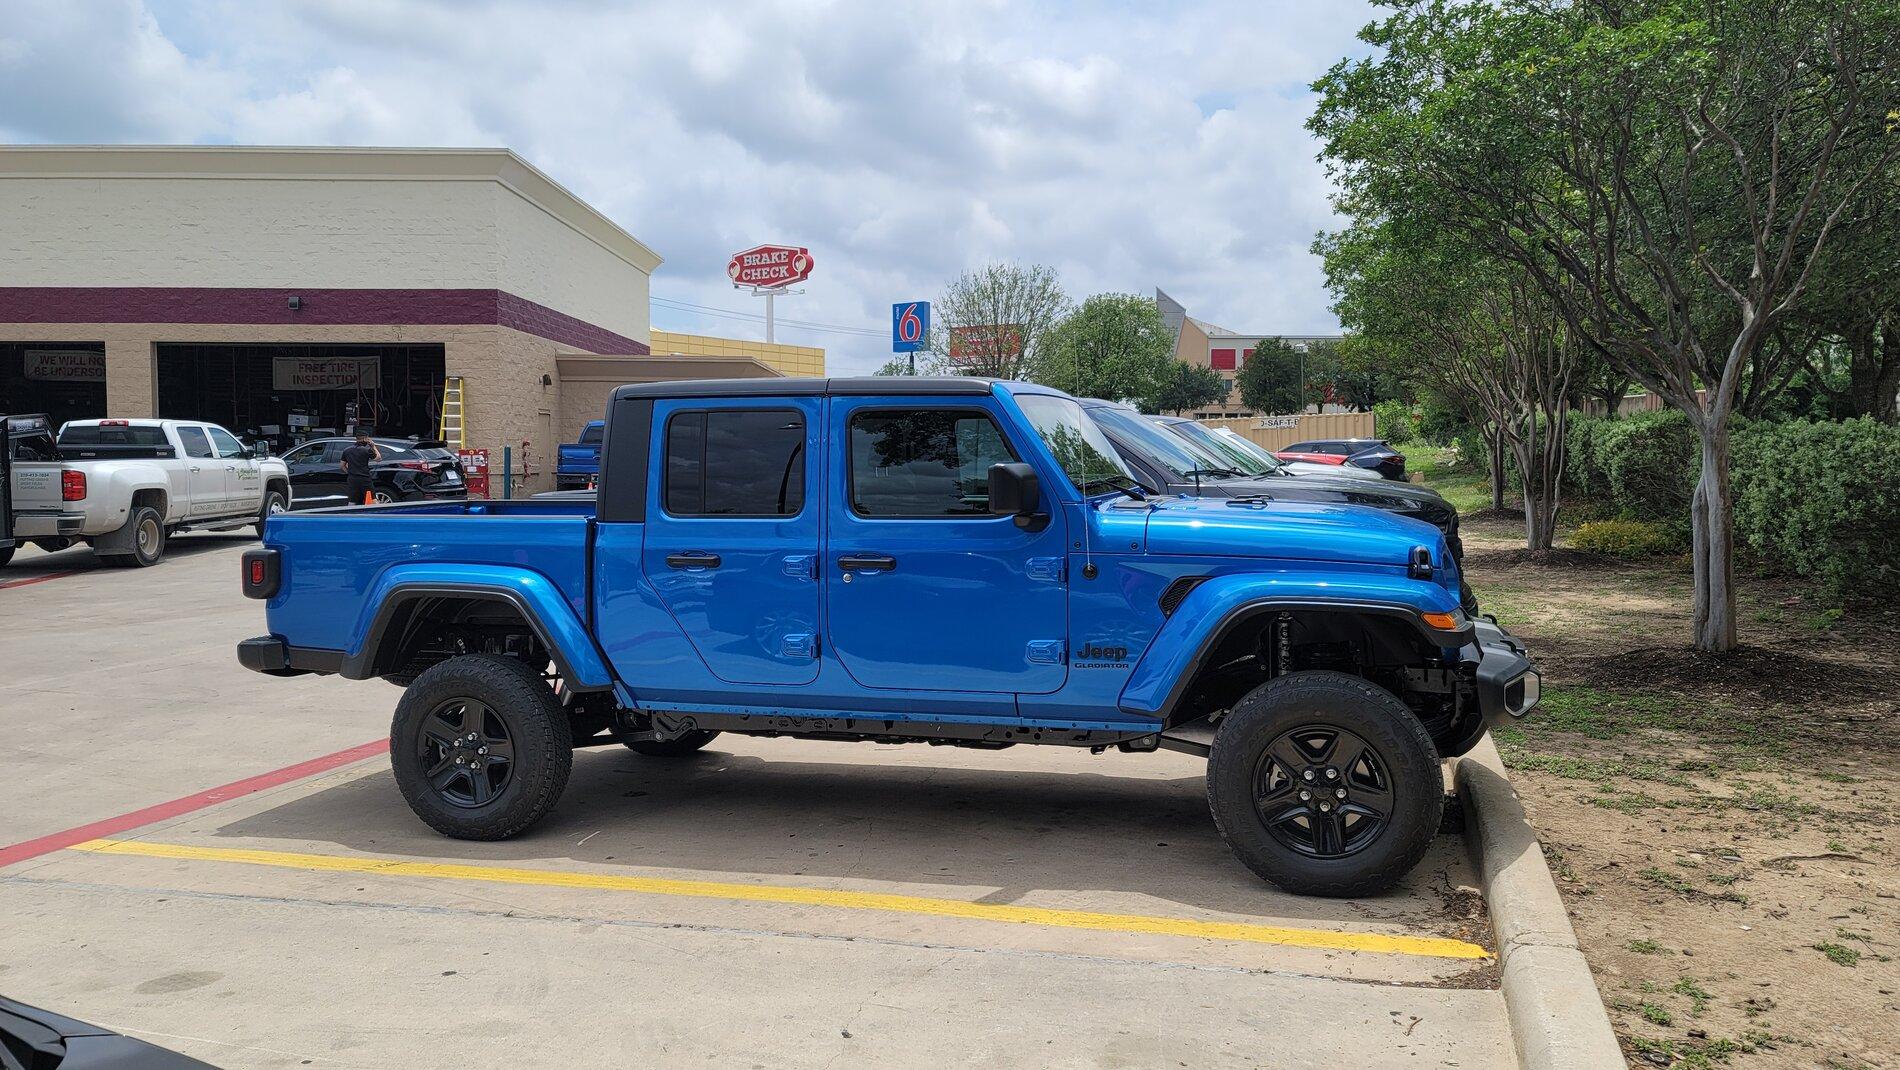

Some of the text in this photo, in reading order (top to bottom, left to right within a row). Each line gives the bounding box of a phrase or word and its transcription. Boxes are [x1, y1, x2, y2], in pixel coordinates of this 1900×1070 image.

[743, 251, 789, 267] BRAKE
[742, 265, 789, 280] CHECK
[899, 303, 921, 342] 6
[40, 355, 106, 366] WE WILL NO
[34, 366, 105, 377] BE UNDERSO
[298, 362, 356, 373] FREE TIRE
[292, 373, 361, 385] INSPECTION
[1076, 642, 1128, 662] Jeep
